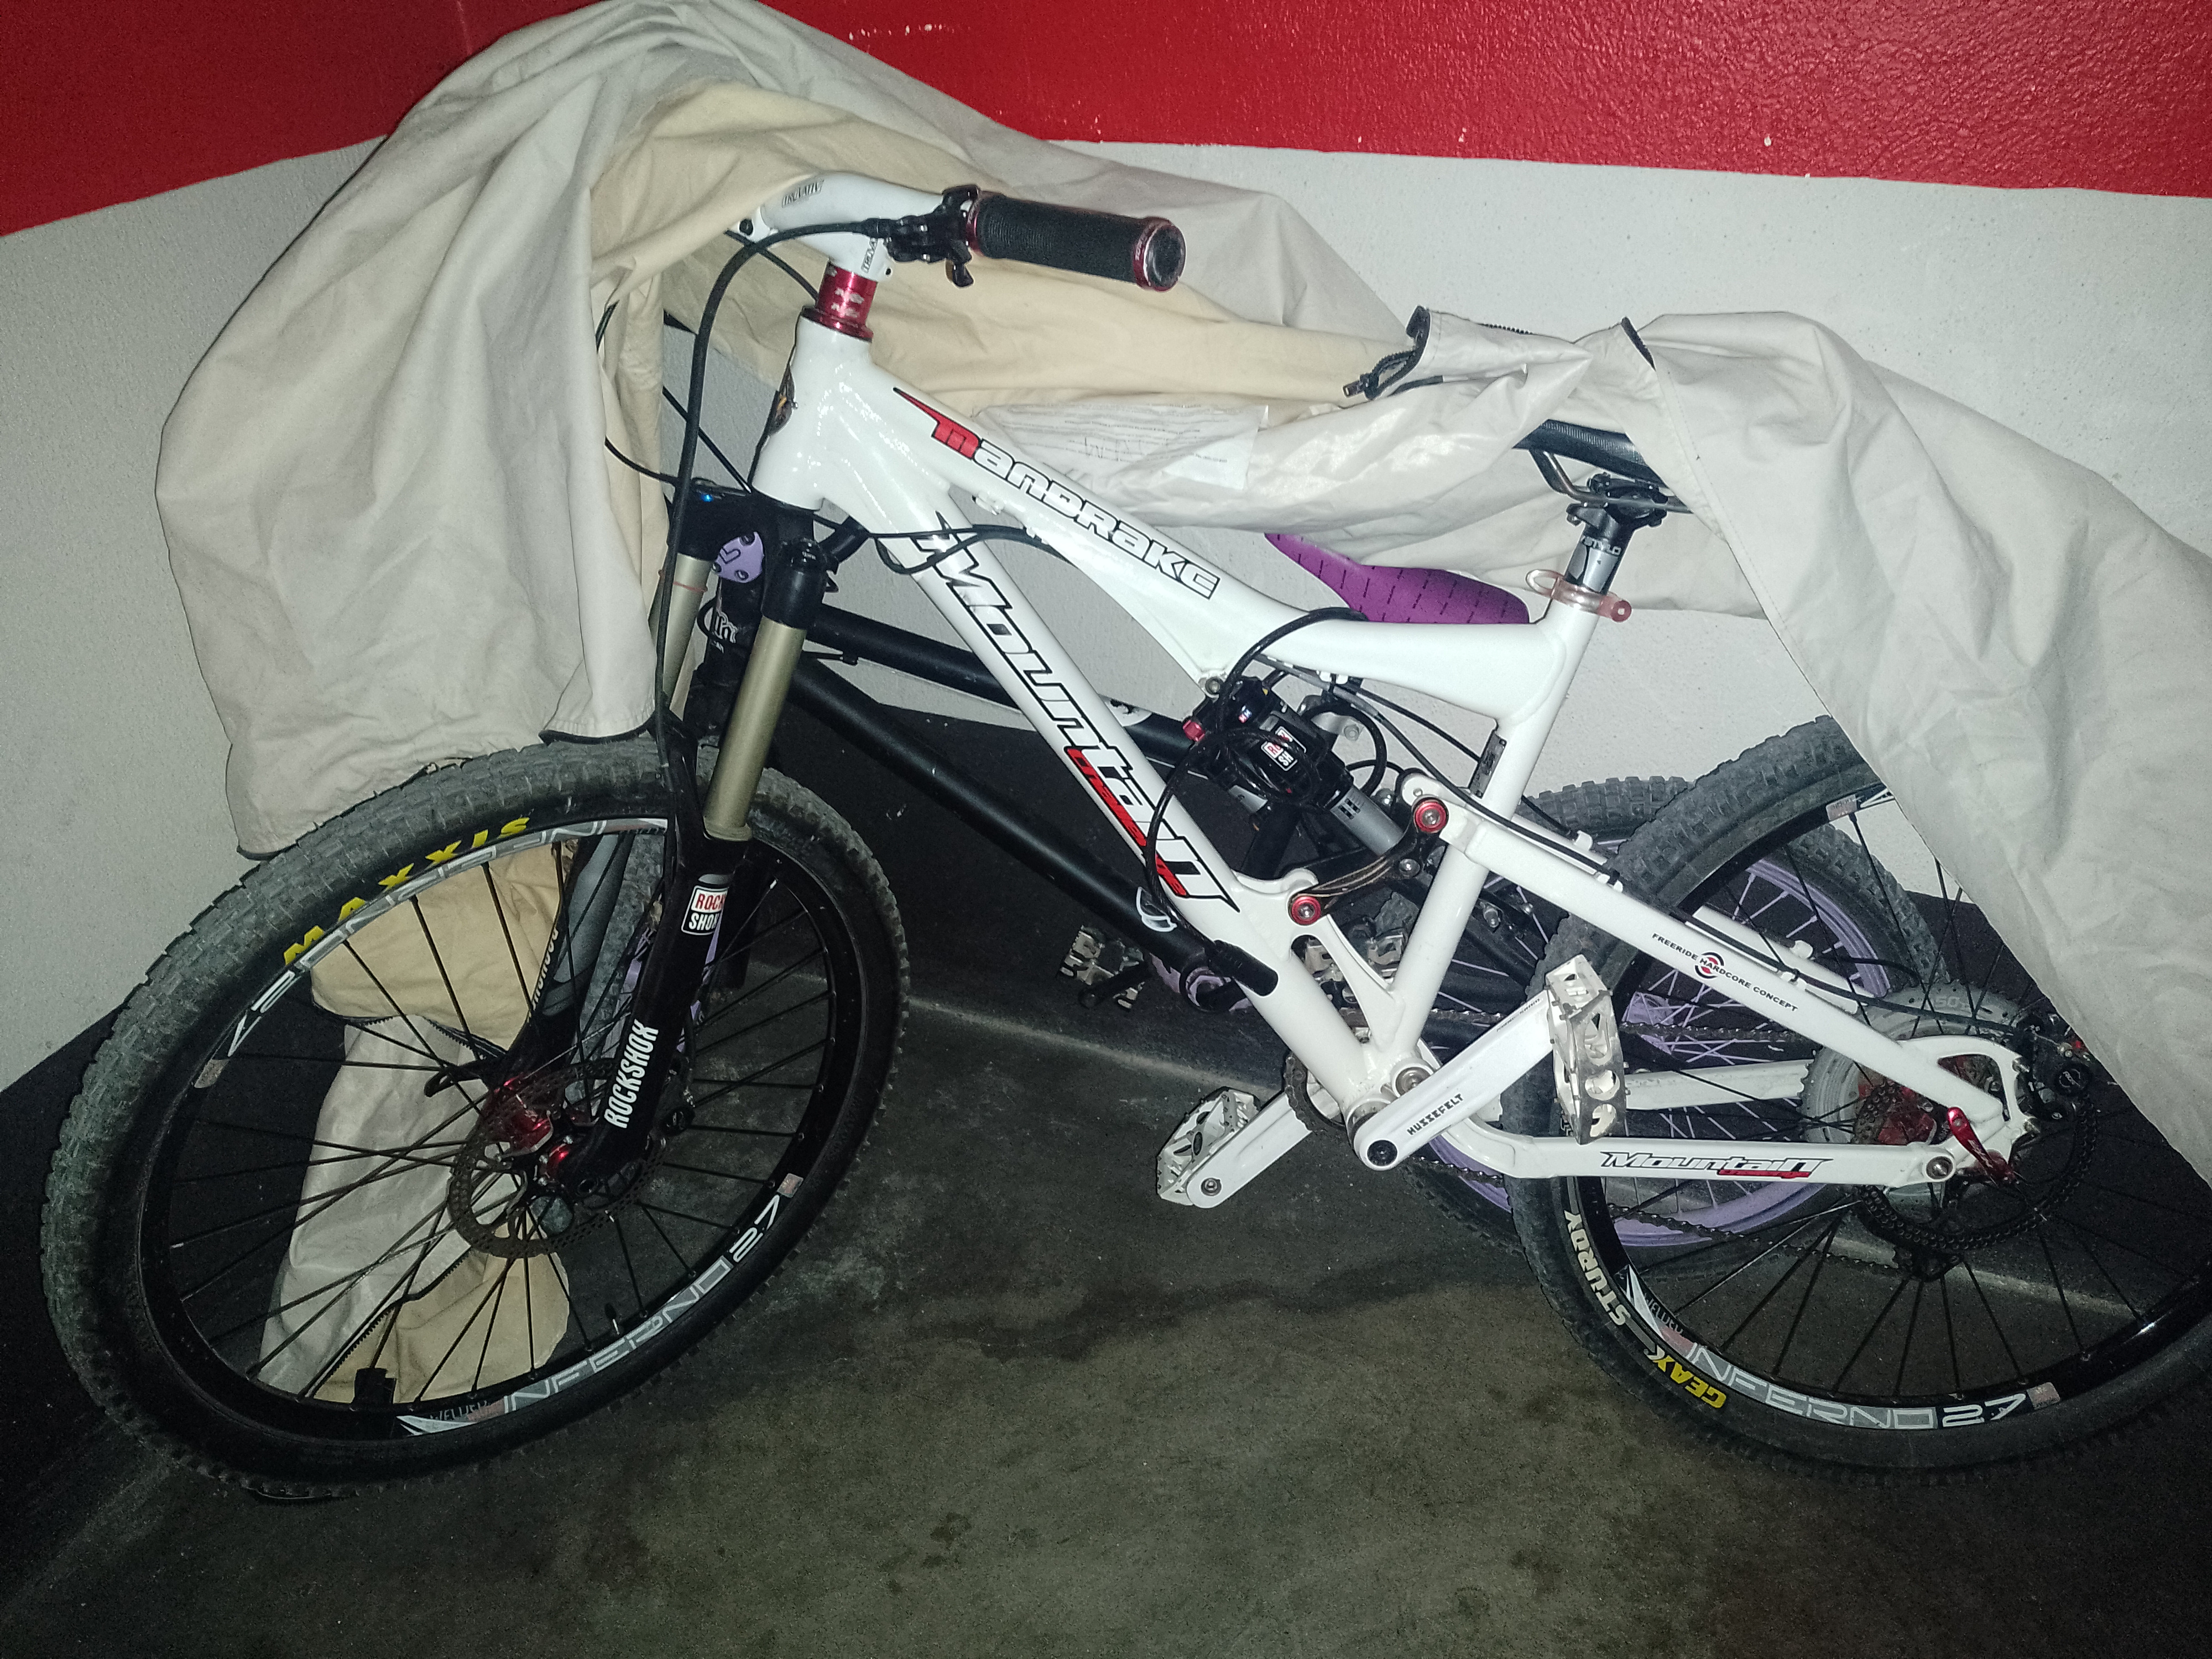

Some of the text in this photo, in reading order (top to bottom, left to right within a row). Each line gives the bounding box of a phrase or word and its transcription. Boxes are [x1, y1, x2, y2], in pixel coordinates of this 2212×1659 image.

[1652, 933, 1798, 1011] FREERIDE HARDCORE CONCEPT
[604, 1019, 659, 1129] ROCKSHOX
[1407, 1093, 1463, 1135] HUSSEFELT
[1600, 1151, 1834, 1178] Mountain
[504, 1194, 780, 1413] INFERNO 27
[1564, 1209, 1631, 1326] STURDY
[1652, 1355, 1728, 1409] GEAX
[1686, 1342, 2028, 1430] INFERNO 27
